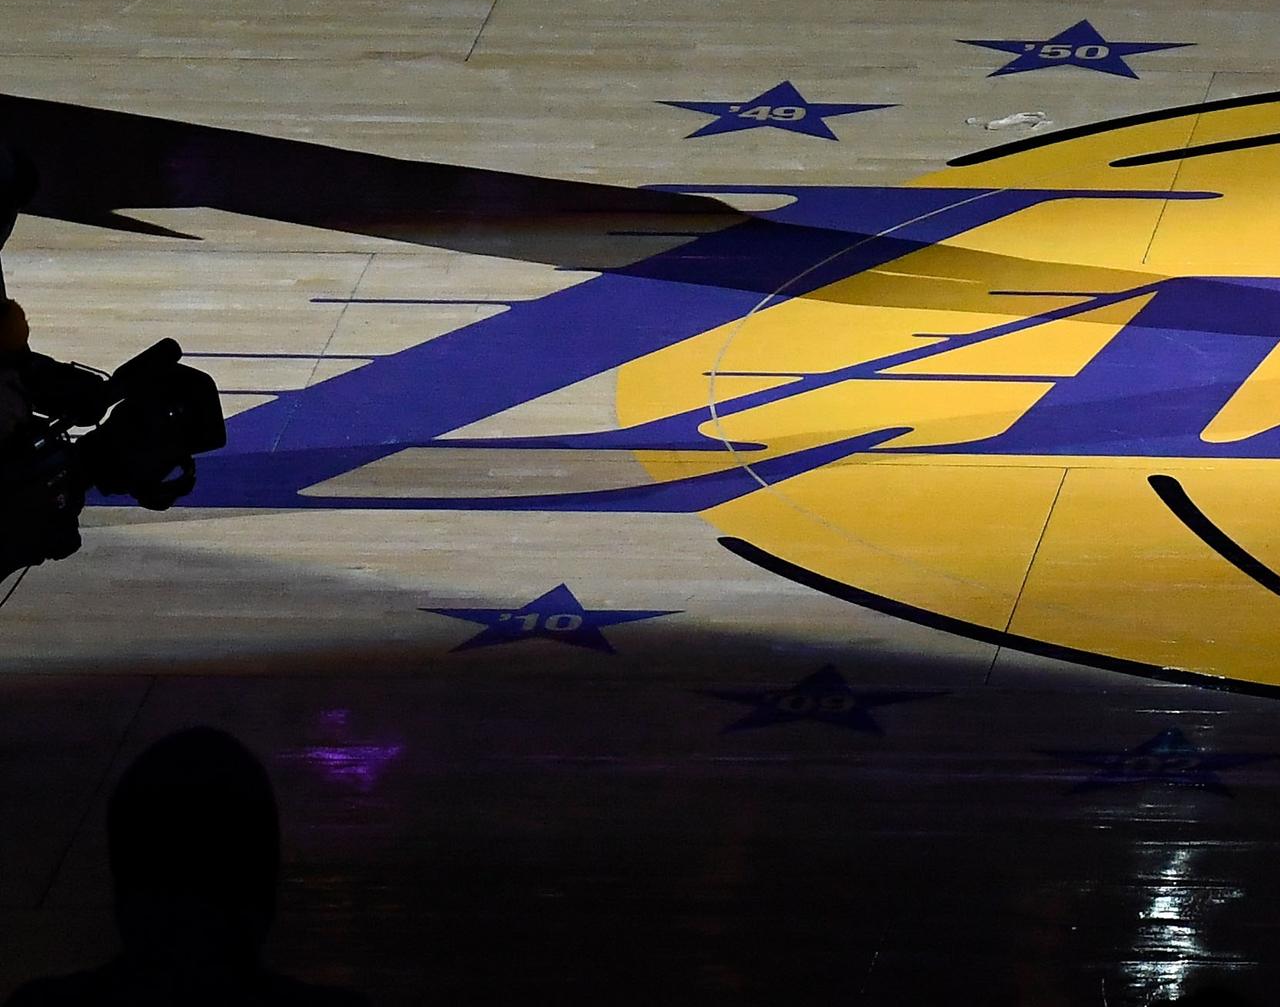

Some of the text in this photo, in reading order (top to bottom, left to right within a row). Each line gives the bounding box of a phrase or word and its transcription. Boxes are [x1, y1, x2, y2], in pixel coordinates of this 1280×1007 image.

[1025, 44, 1110, 60] '50
[728, 104, 807, 122] '49
[498, 612, 583, 632] '10
